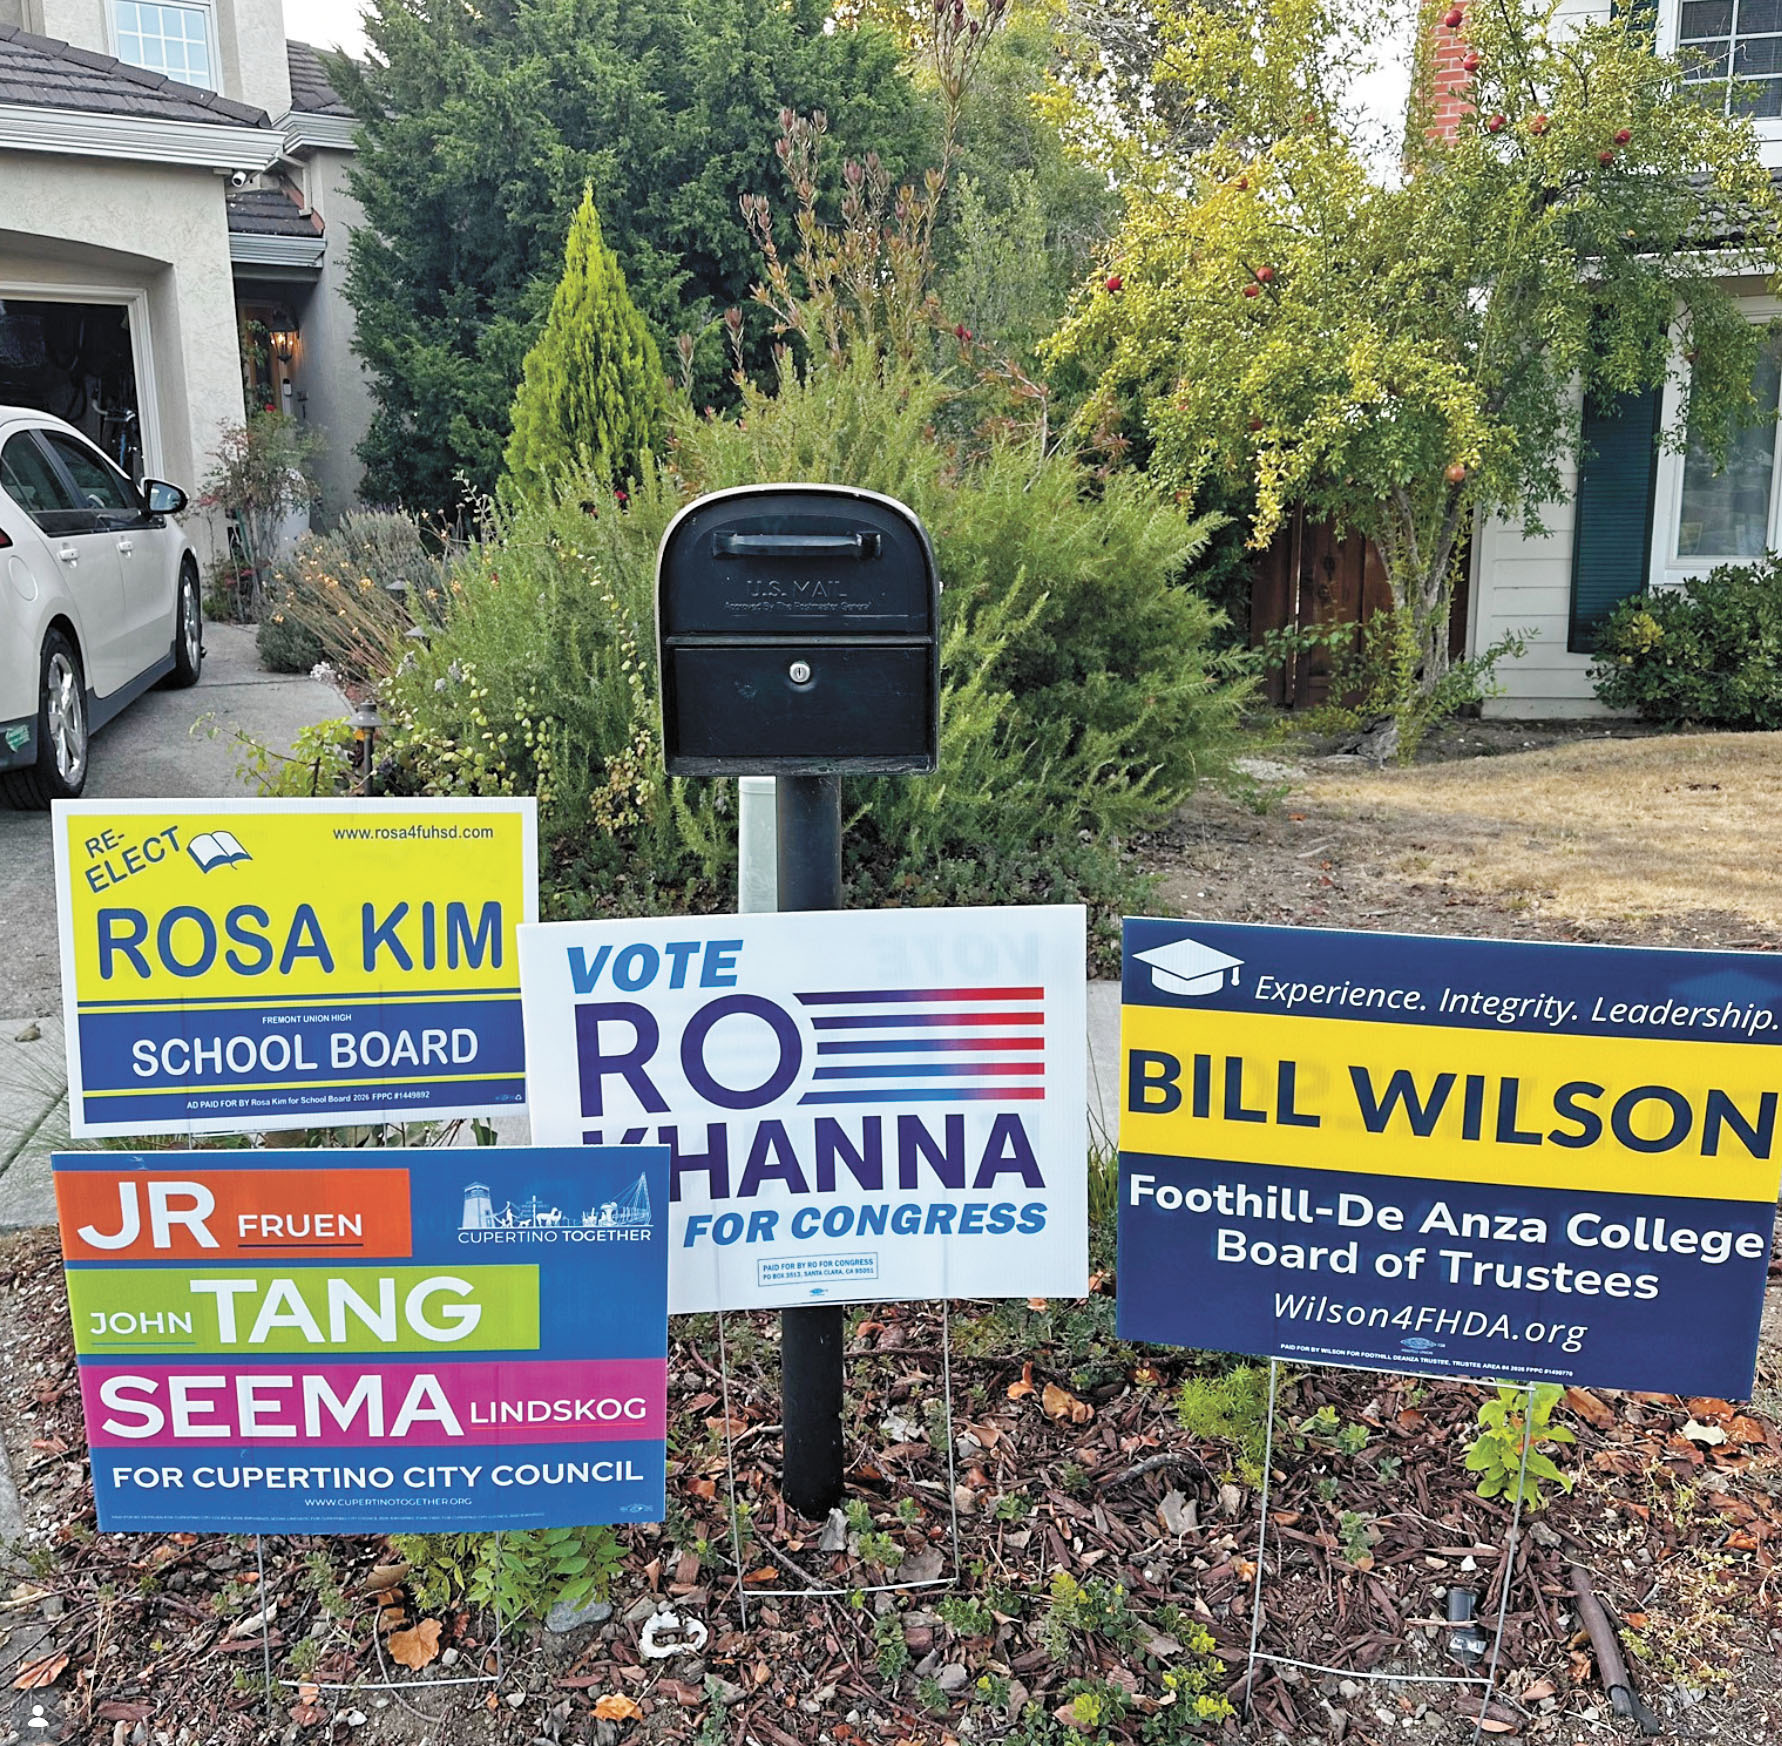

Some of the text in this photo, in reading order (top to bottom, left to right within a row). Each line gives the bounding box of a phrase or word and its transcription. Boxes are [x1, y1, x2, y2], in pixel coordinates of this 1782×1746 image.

[747, 580, 848, 598] U.S. MAIL
[85, 828, 125, 859] RE-
[85, 825, 181, 893] ELECT
[333, 824, 493, 841] www.rosa4fuhsd.com
[97, 900, 502, 980] ROSA KIM
[567, 939, 744, 994] VOTE
[262, 1012, 352, 1024] FREMONT UNION HIGH
[1255, 974, 1780, 1036] Experience. Integrity. Leadership.
[132, 1027, 479, 1078] SCHOOL BOARD
[575, 994, 803, 1118] RO
[187, 1101, 199, 1109] AD
[200, 1100, 219, 1109] PAID
[220, 1099, 237, 1108] FOR
[239, 1099, 250, 1107] BY
[251, 1098, 271, 1106] Rosa
[272, 1097, 287, 1105] Kim
[288, 1097, 299, 1105] for
[301, 1096, 327, 1104] School
[328, 1095, 351, 1103] Board
[372, 1092, 393, 1101] FPPC
[1127, 1049, 1779, 1160] BILL WILSON
[582, 1113, 1046, 1203] HANNA
[77, 1180, 363, 1249] JR FRUEN
[458, 1229, 651, 1244] CUPERTINO TOGETHER
[683, 1202, 1047, 1248] FOR CONGRESS
[1129, 1174, 1765, 1265] Foothill-De Anza College
[763, 1264, 780, 1272] PAID
[781, 1263, 795, 1271] FOR
[835, 1258, 874, 1267] CONGRESS
[772, 1272, 785, 1280] BOX
[1216, 1229, 1660, 1300] Board of Trustees
[90, 1276, 482, 1344] JOHN TANG
[1274, 1293, 1588, 1352] Wilson4FHDA.org
[1280, 1343, 1296, 1351] PAID
[1321, 1347, 1345, 1355] WILSON
[1361, 1351, 1391, 1360] FOOTHILL
[1393, 1355, 1419, 1363] DEANZA
[1452, 1360, 1481, 1368] TRUSTEE
[1482, 1362, 1501, 1370] AREA
[99, 1373, 647, 1439] SEEMA LINDSKOG
[113, 1461, 644, 1489] FOR CUPERTINO CITY COUNCIL
[304, 1497, 472, 1507] WWW.CUPERTINOTOGETHER.ORG
